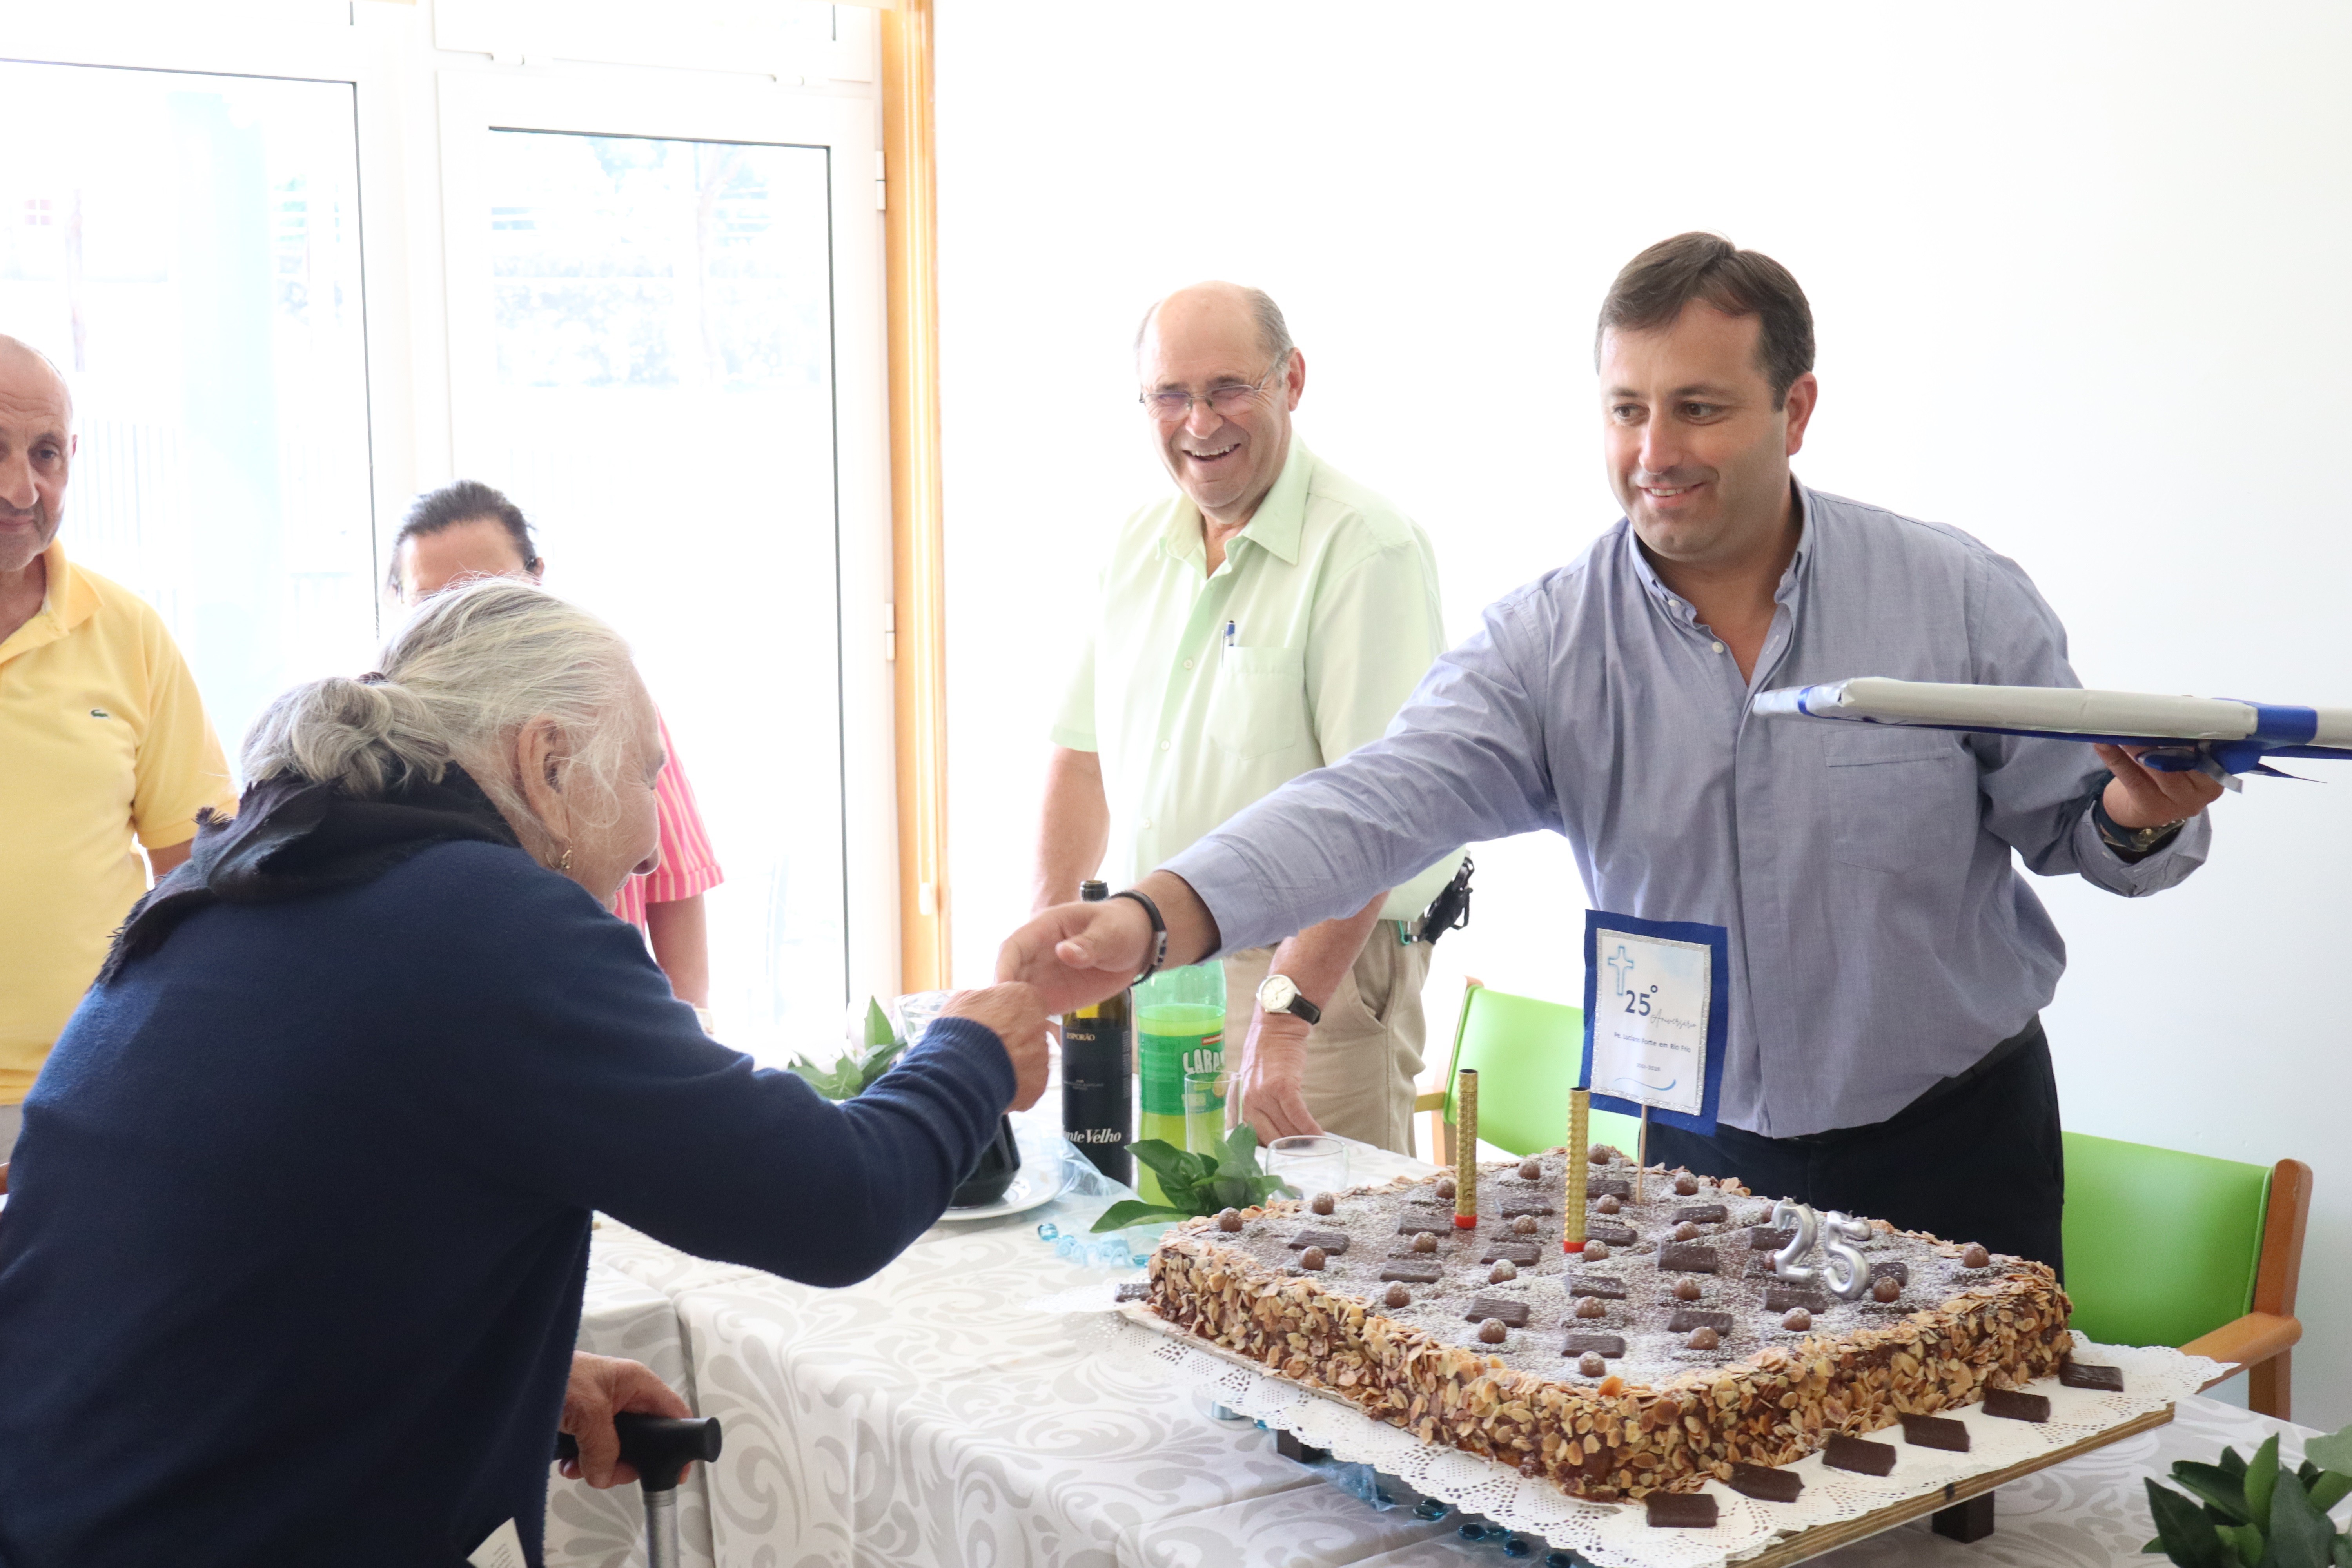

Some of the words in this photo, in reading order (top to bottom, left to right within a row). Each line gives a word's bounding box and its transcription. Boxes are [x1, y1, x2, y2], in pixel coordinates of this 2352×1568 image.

[1641, 1038, 1657, 1046] Forte
[1085, 1128, 1122, 1144] Velho
[1771, 1201, 1872, 1301] 25
